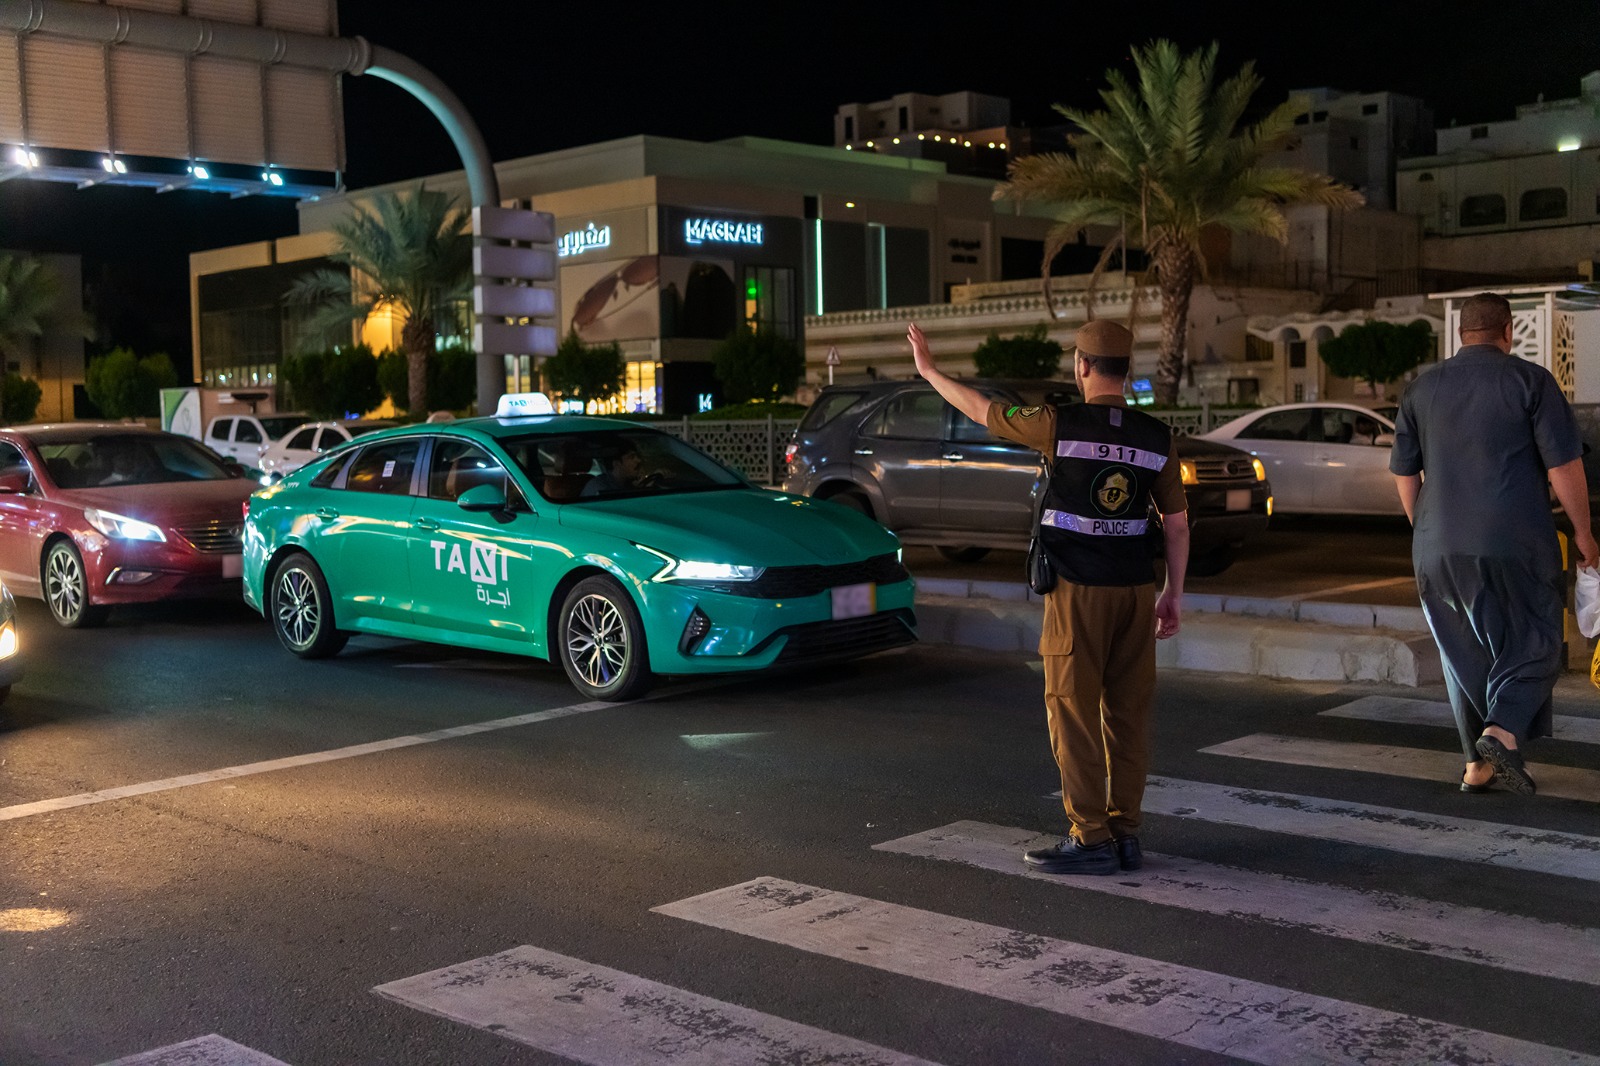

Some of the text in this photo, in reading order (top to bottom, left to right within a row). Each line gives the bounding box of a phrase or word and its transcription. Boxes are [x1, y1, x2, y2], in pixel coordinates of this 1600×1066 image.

[686, 218, 763, 244] MAGRABI
[1098, 445, 1136, 462] 911
[1093, 521, 1128, 535] POLICE
[430, 540, 508, 585] TAXI
